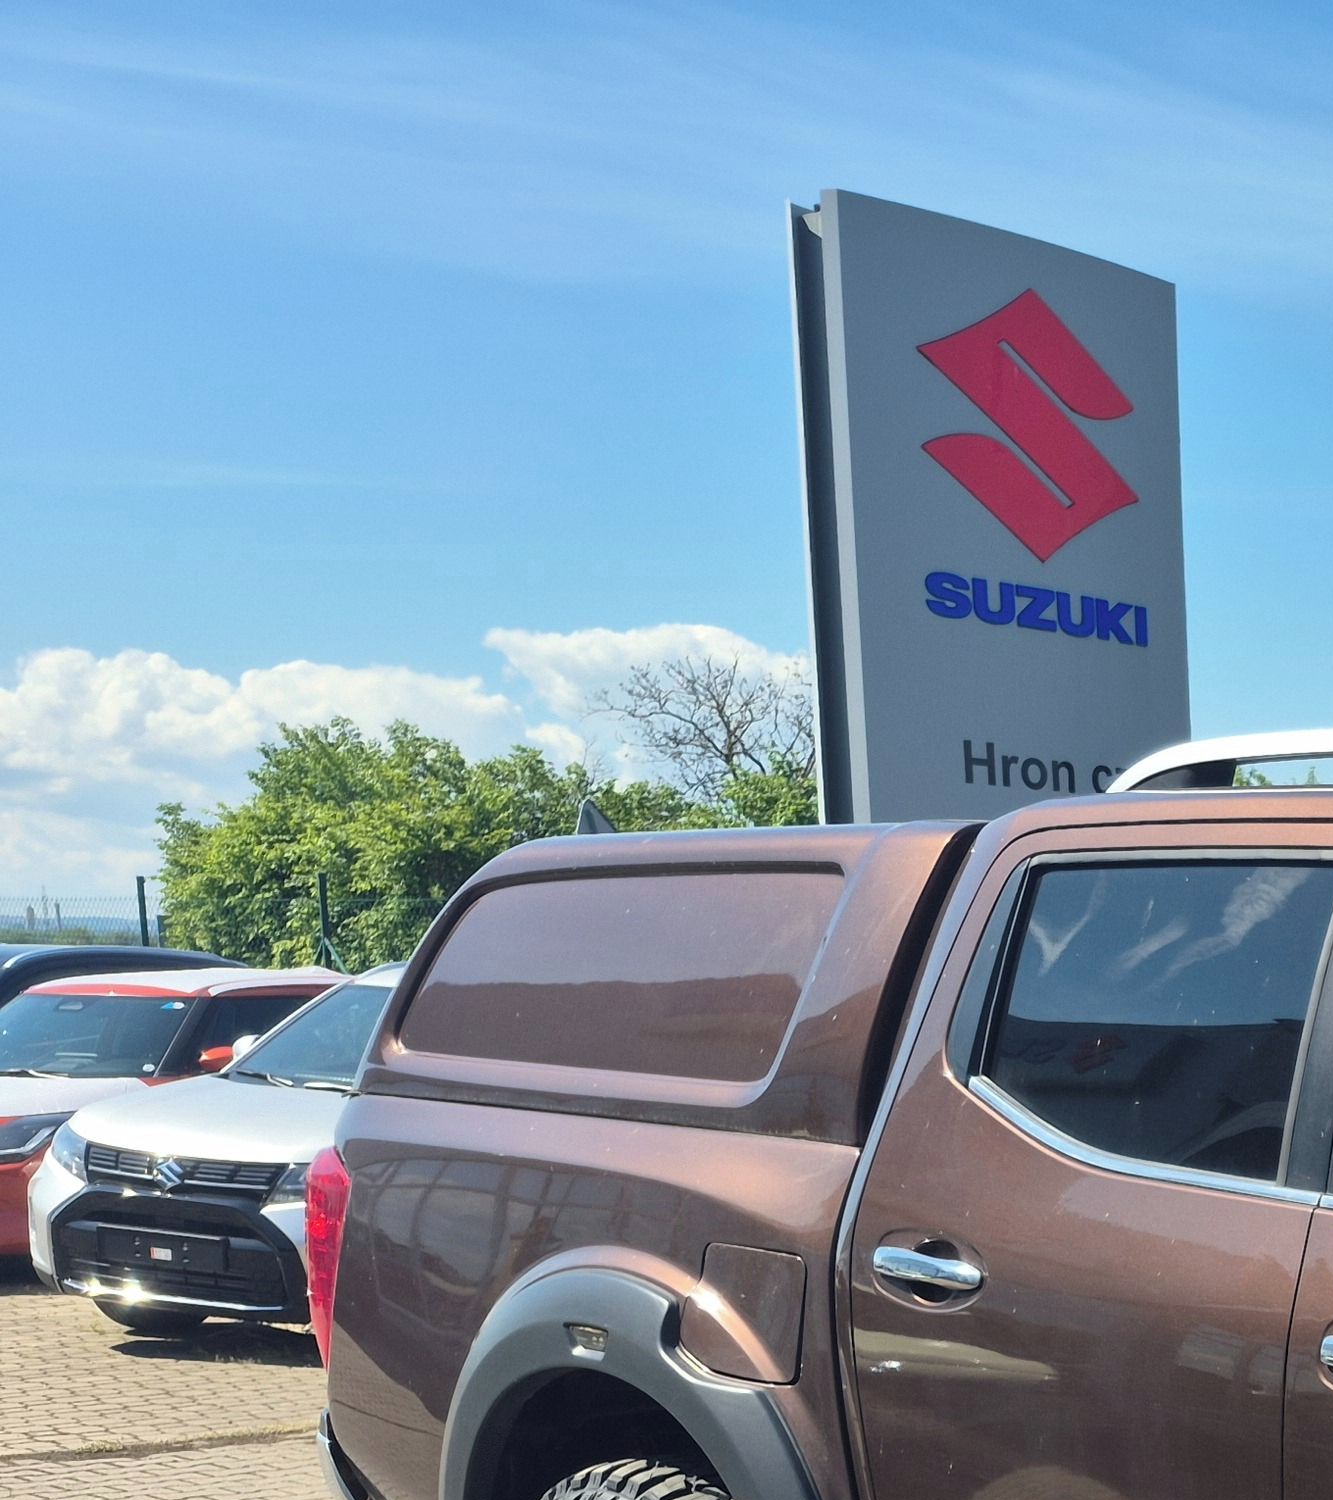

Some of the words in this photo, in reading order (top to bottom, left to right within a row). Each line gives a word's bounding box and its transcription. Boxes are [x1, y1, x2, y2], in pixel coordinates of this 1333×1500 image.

[924, 571, 1149, 648] SUZUKI
[962, 739, 1077, 794] Hron
[1091, 764, 1128, 794] c
